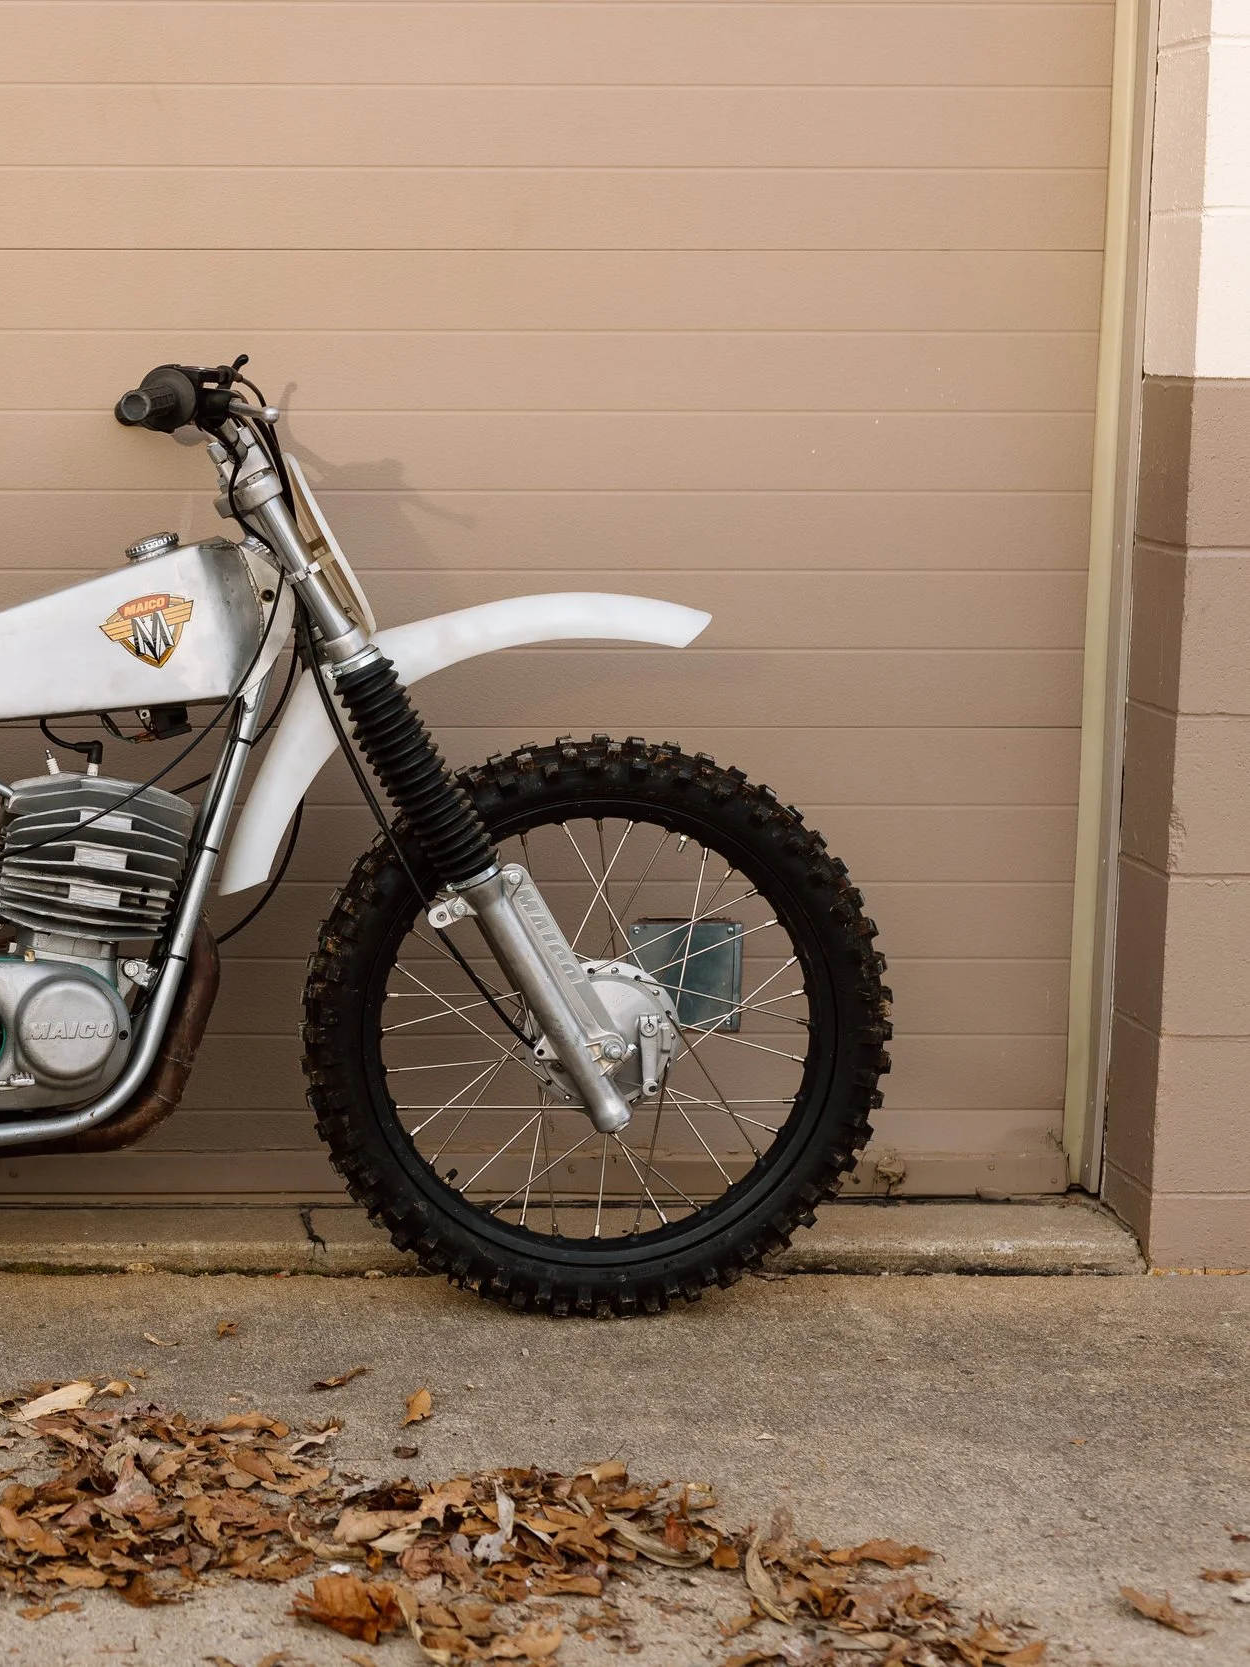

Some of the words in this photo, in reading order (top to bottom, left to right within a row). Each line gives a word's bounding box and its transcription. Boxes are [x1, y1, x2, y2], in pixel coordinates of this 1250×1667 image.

[124, 598, 166, 616] MAICO
[516, 888, 579, 983] MAICO
[29, 1021, 115, 1040] MAICO
